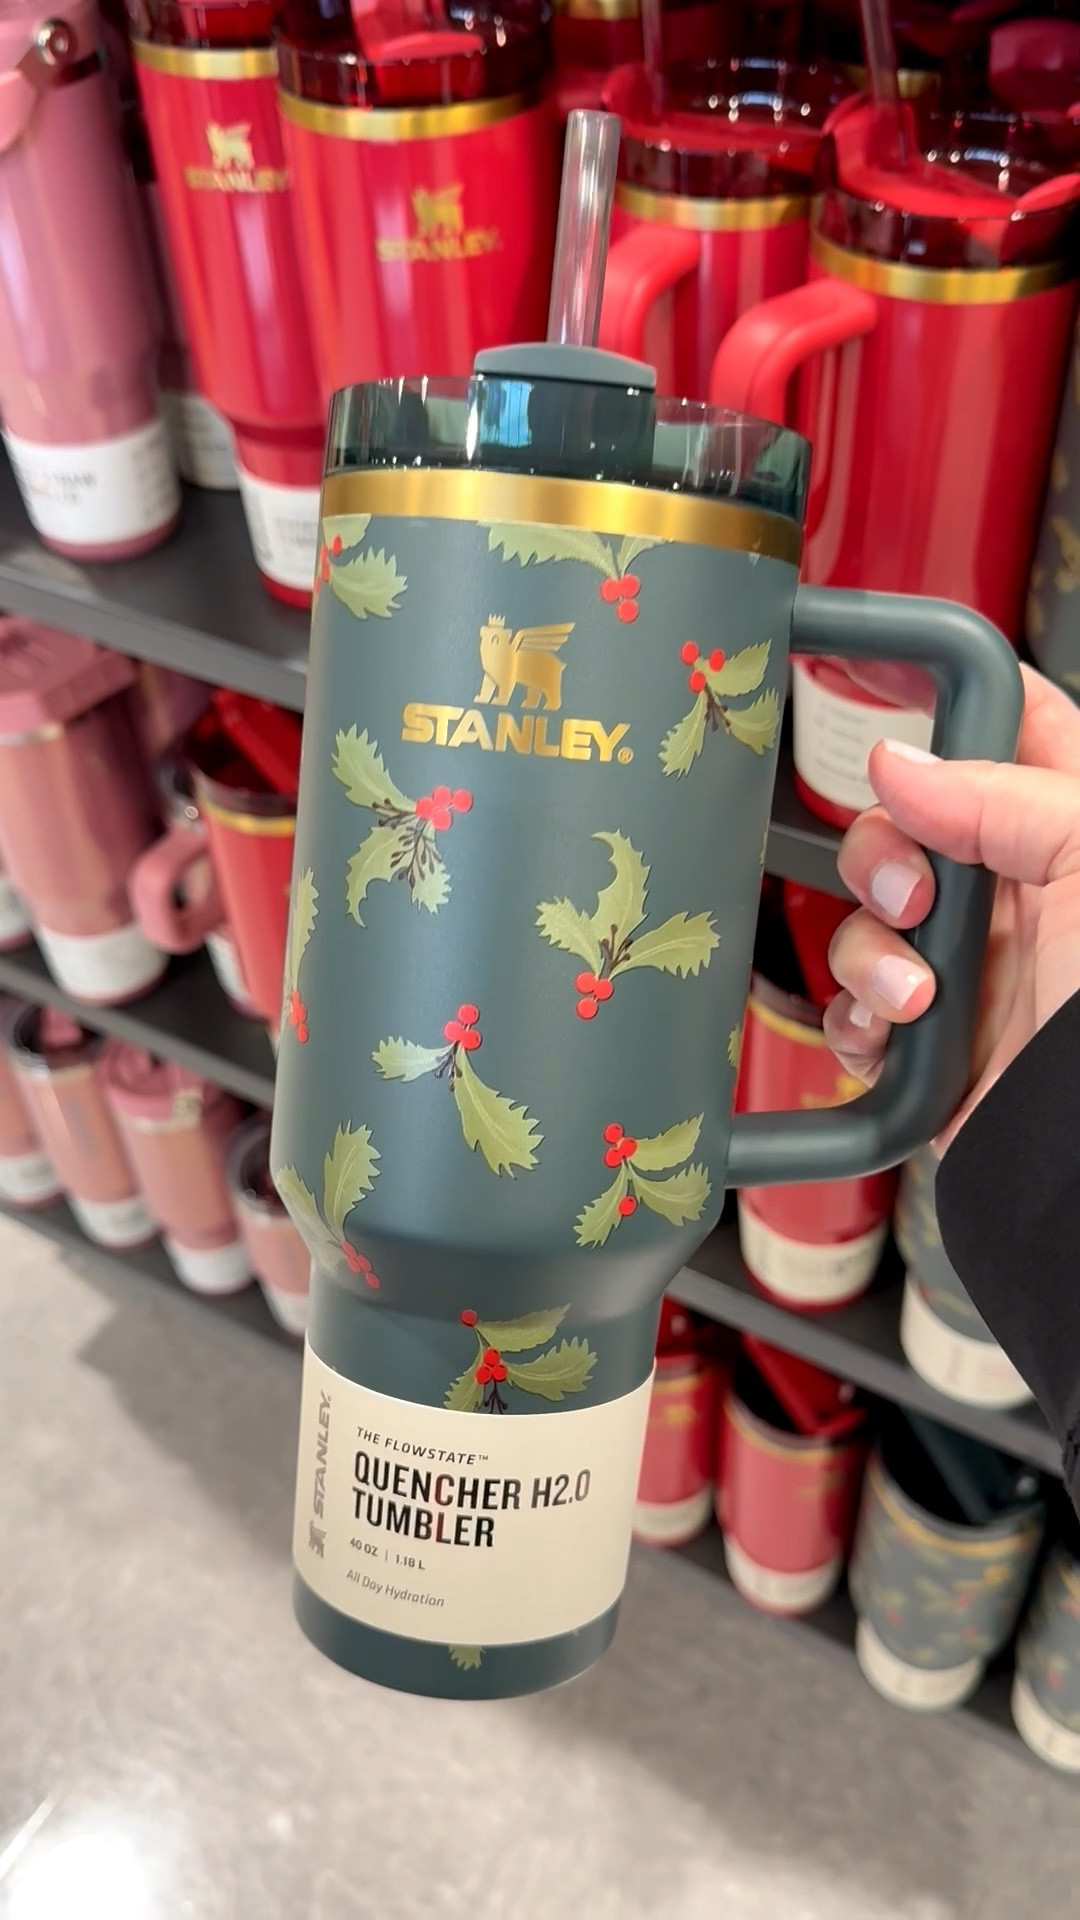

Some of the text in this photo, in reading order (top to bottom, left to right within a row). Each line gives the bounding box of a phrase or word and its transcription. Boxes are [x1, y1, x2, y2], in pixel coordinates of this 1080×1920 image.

[356, 1426, 381, 1444] THE
[354, 1450, 591, 1510] QUENCHER H2.0
[352, 1486, 495, 1547] TUMBLER
[349, 1537, 426, 1570] 40 OZ 1.18 L
[346, 1569, 445, 1607] All Day Hydration
